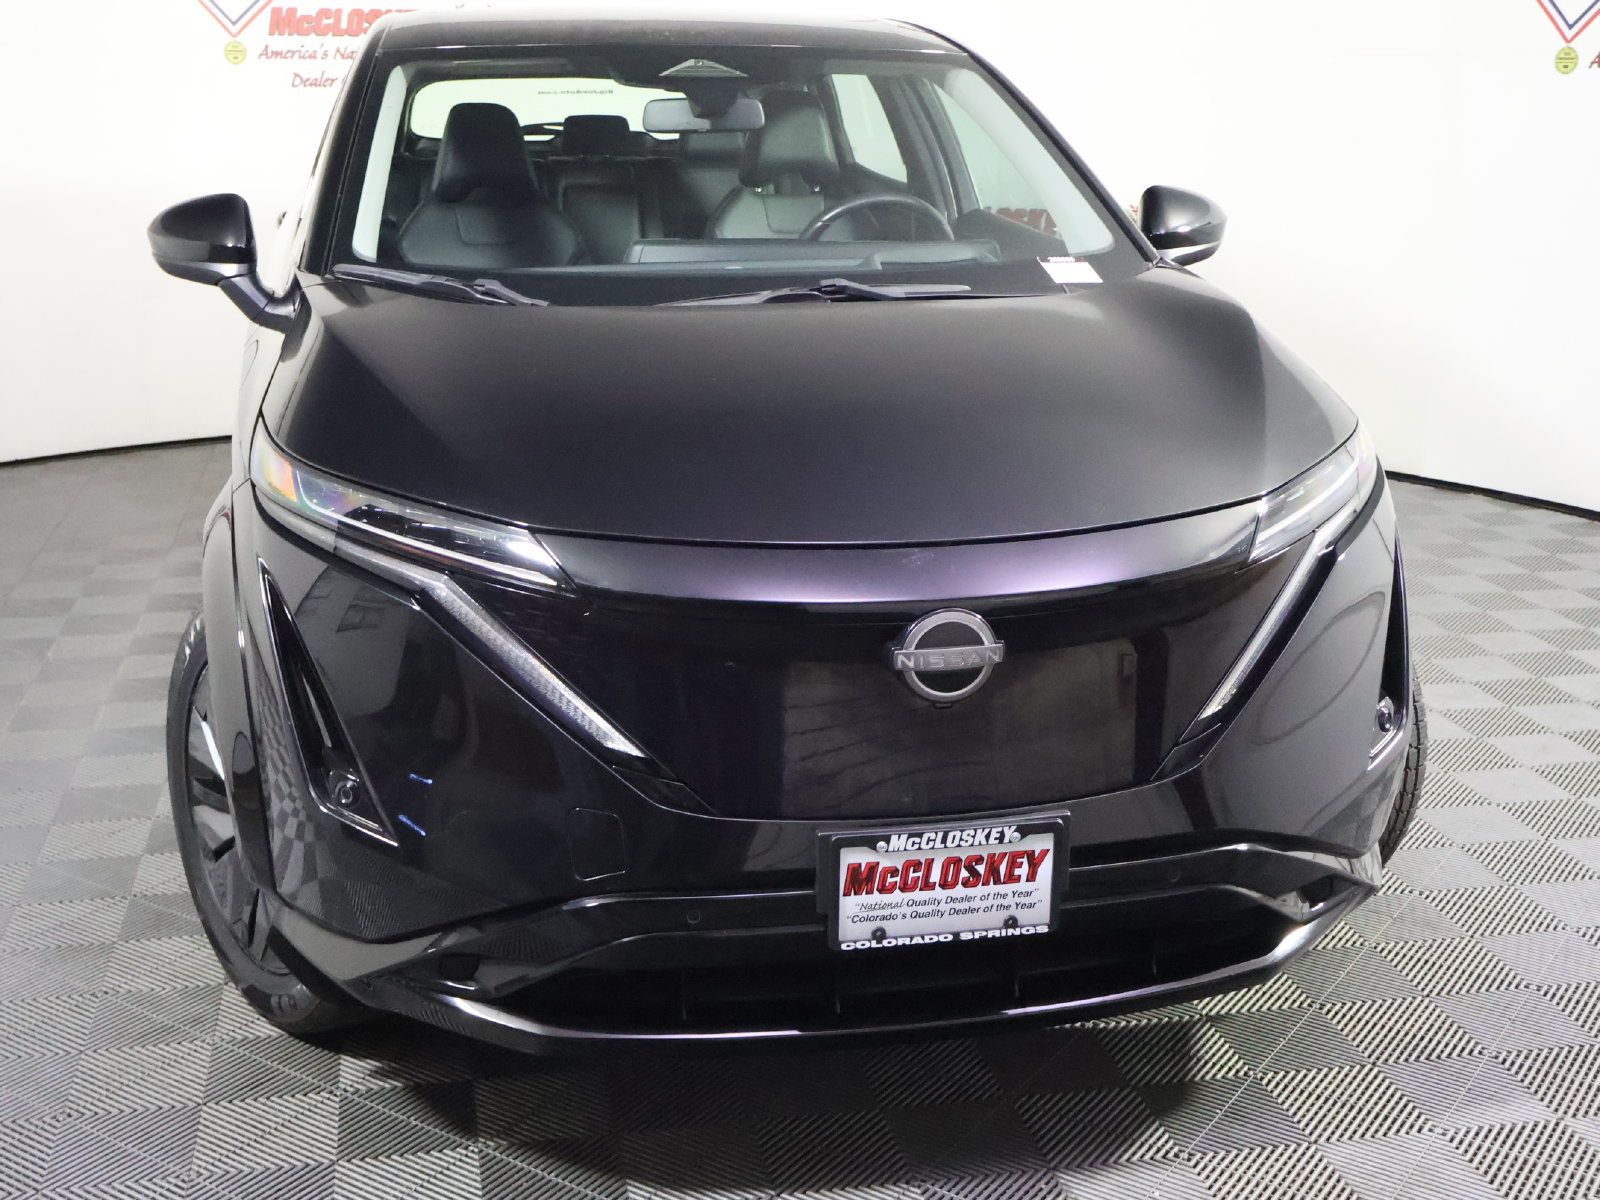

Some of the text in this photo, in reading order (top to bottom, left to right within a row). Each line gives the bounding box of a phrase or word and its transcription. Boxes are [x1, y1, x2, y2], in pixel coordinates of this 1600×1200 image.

[258, 44, 328, 60] America's
[291, 71, 338, 88] Dealer
[897, 648, 1000, 669] NISSAN
[887, 825, 1018, 852] McCLOSKEY
[842, 848, 1050, 897] McCLOSKEY
[906, 897, 943, 909] Quality
[945, 894, 977, 905] Dealer
[980, 891, 990, 902] of
[992, 890, 1009, 901] the
[910, 908, 946, 921] Quality
[948, 904, 981, 916] Dealer
[983, 902, 995, 913] of
[996, 902, 1011, 912] the
[840, 925, 1049, 951] COLORADO SPRINGS
